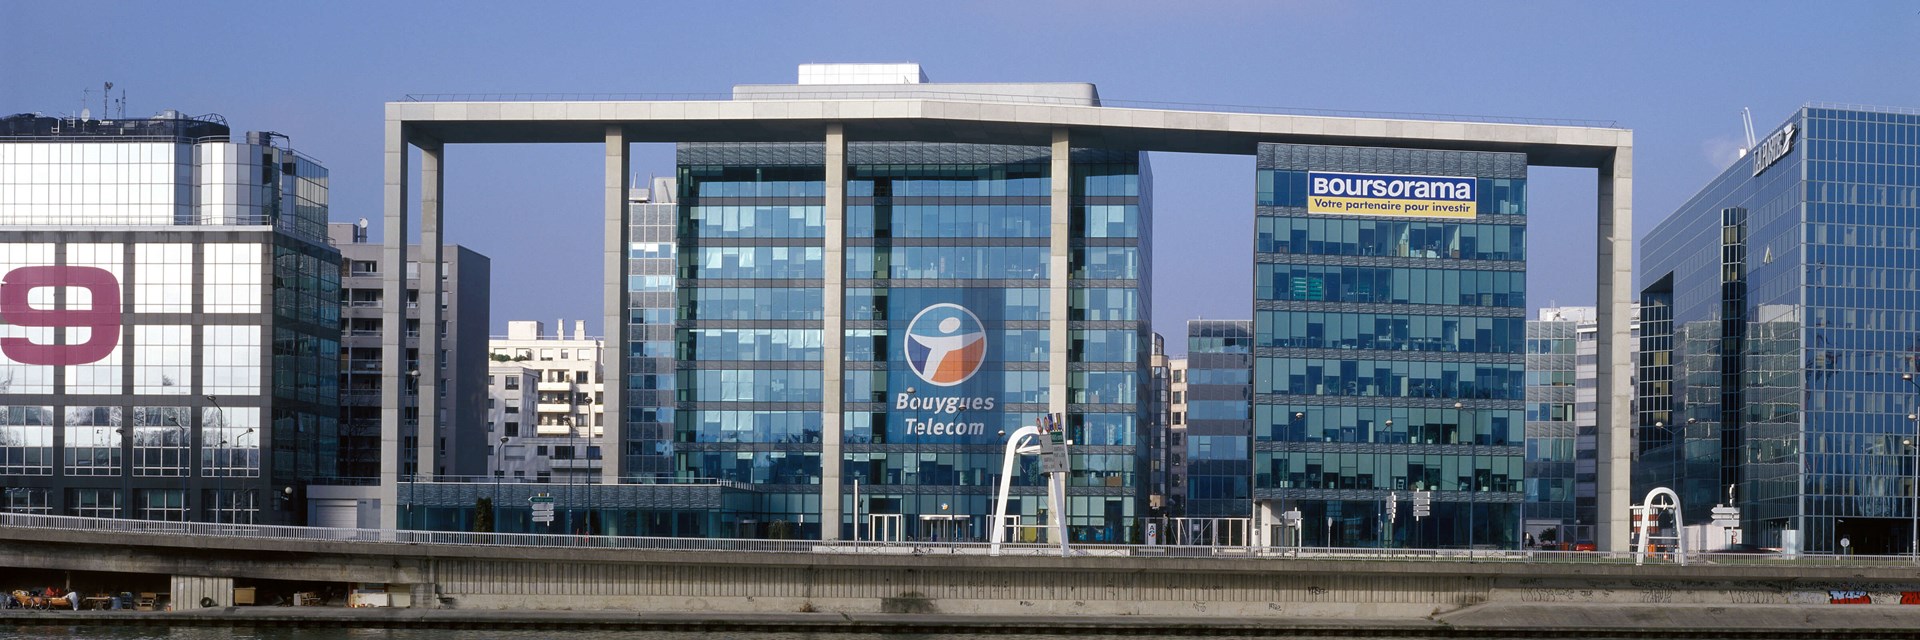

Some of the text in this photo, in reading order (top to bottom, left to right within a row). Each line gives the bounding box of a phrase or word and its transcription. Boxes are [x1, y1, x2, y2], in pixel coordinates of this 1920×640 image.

[1314, 198, 1471, 212] Votre partenaire pour investir
[0, 265, 121, 366] 9
[896, 392, 995, 414] Bouygues
[905, 418, 985, 435] Telecom
